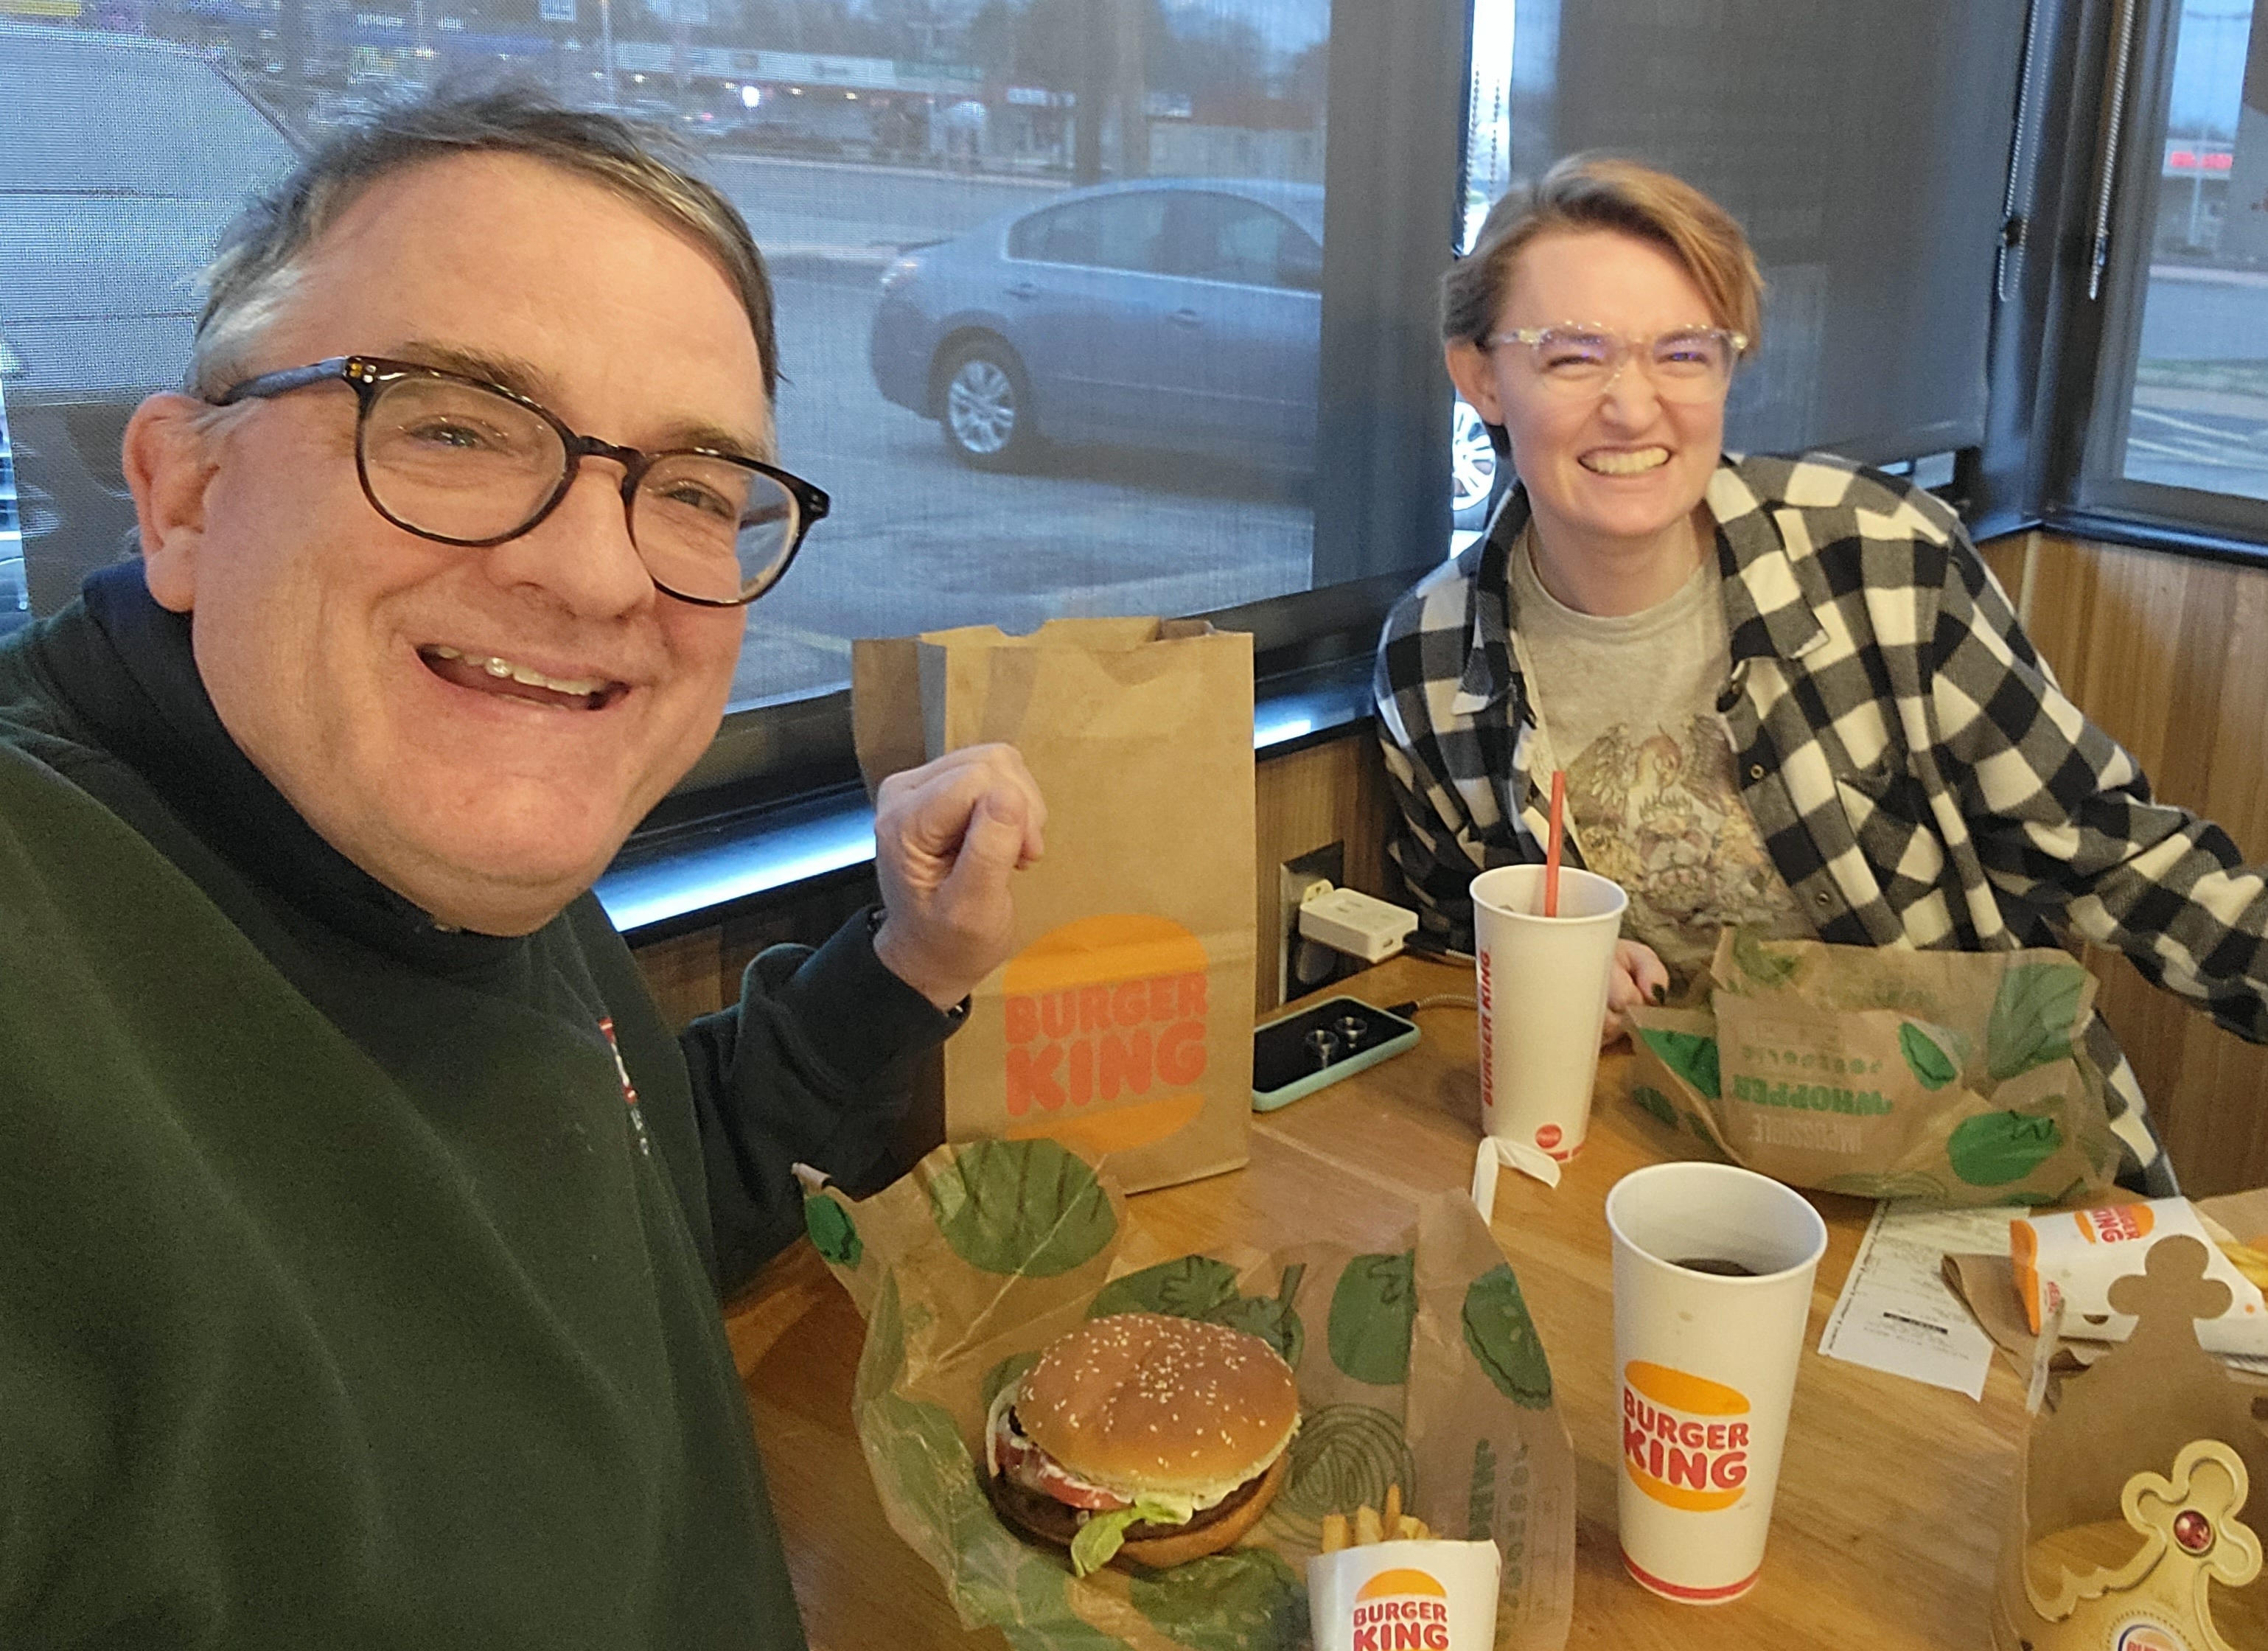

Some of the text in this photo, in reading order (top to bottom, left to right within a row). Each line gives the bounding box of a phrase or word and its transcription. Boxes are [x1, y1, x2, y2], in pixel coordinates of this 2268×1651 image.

[1005, 971, 1208, 1044] BURGER
[1481, 949, 1493, 1106] BURGER KING
[1005, 1021, 1207, 1117] KING
[1624, 1386, 1749, 1450] BURGER
[1624, 1415, 1748, 1490] KING
[1353, 1602, 1448, 1627] BURGER
[1353, 1622, 1449, 1651] KING
